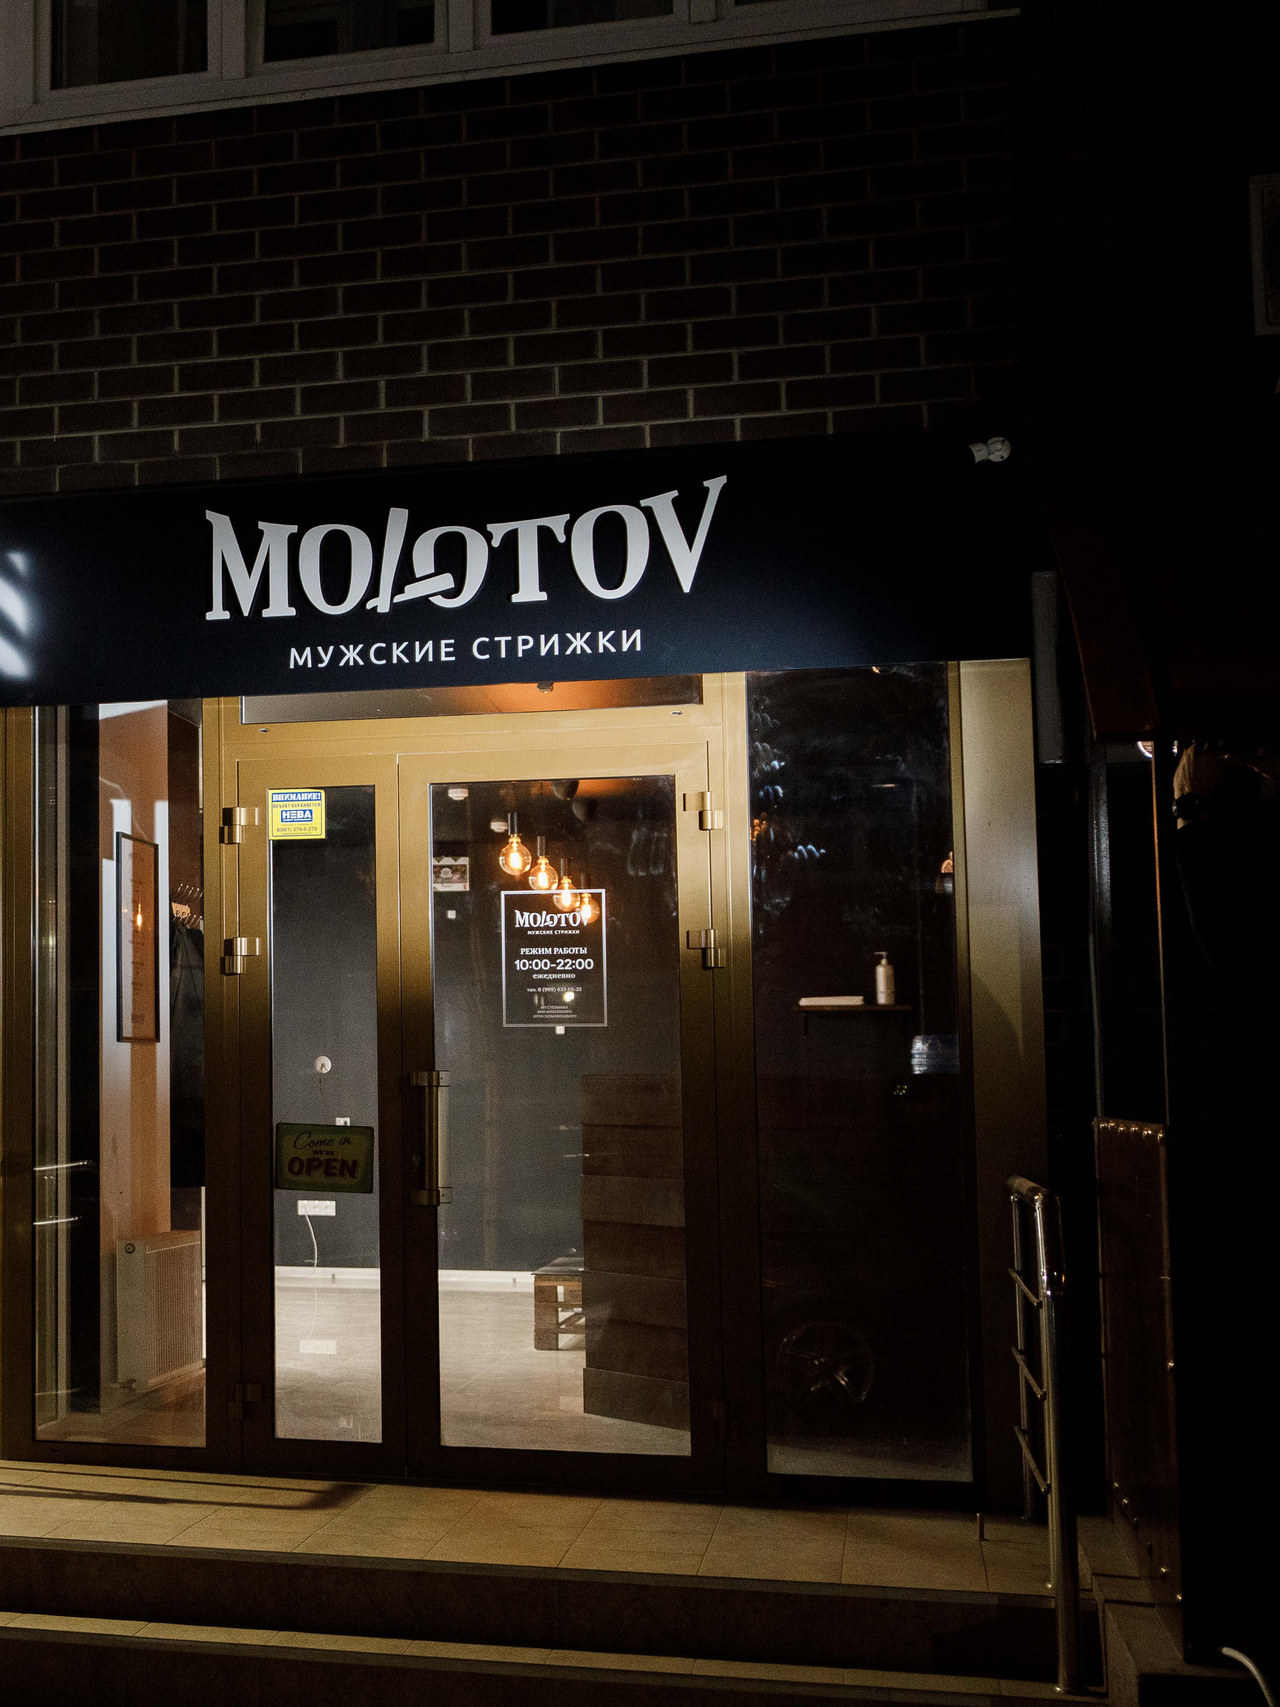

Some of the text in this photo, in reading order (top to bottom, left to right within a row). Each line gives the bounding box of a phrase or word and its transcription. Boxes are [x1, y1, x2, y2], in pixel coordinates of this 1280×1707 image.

[204, 475, 727, 621] MOLOTOV
[288, 629, 642, 670] МУЖСКИЕ СТРИЖКИ
[272, 793, 321, 801] ВНИМАНИЕ!
[520, 946, 588, 955] РЕЖИМ РАБОТЫ
[514, 958, 594, 971] 10:00-22:00
[294, 1131, 334, 1150] Come
[288, 1157, 357, 1178] OPEN
